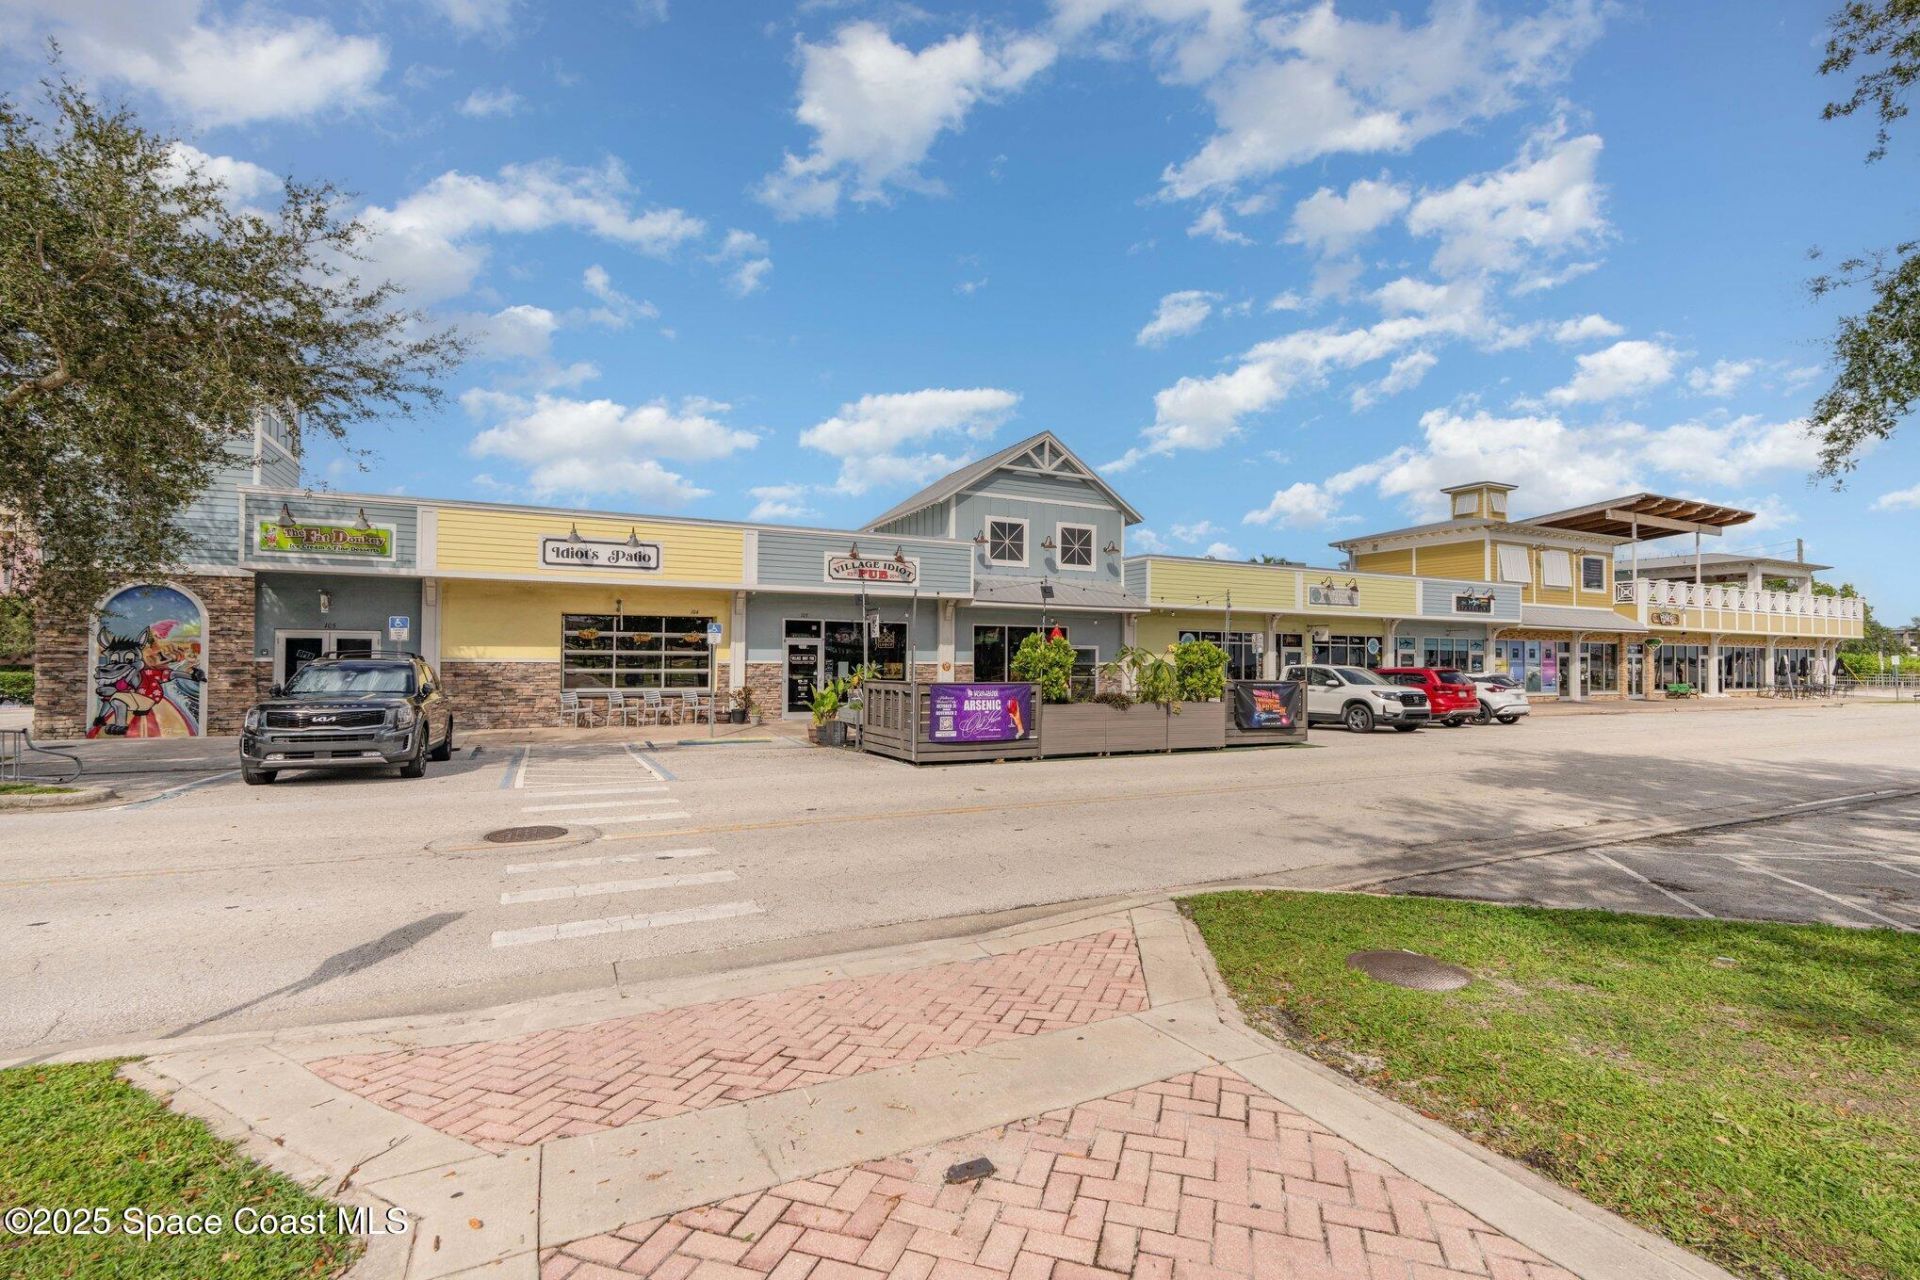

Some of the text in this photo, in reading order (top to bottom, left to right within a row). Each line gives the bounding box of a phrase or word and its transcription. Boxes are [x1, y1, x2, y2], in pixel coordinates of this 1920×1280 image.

[284, 527, 386, 547] The Fat Donkey
[350, 546, 380, 554] Desserts
[551, 546, 652, 564] Idiot's Patio
[833, 560, 914, 578] VILLAGE IDIOT
[857, 569, 889, 579] PUB
[963, 699, 1002, 711] ARSENIC
